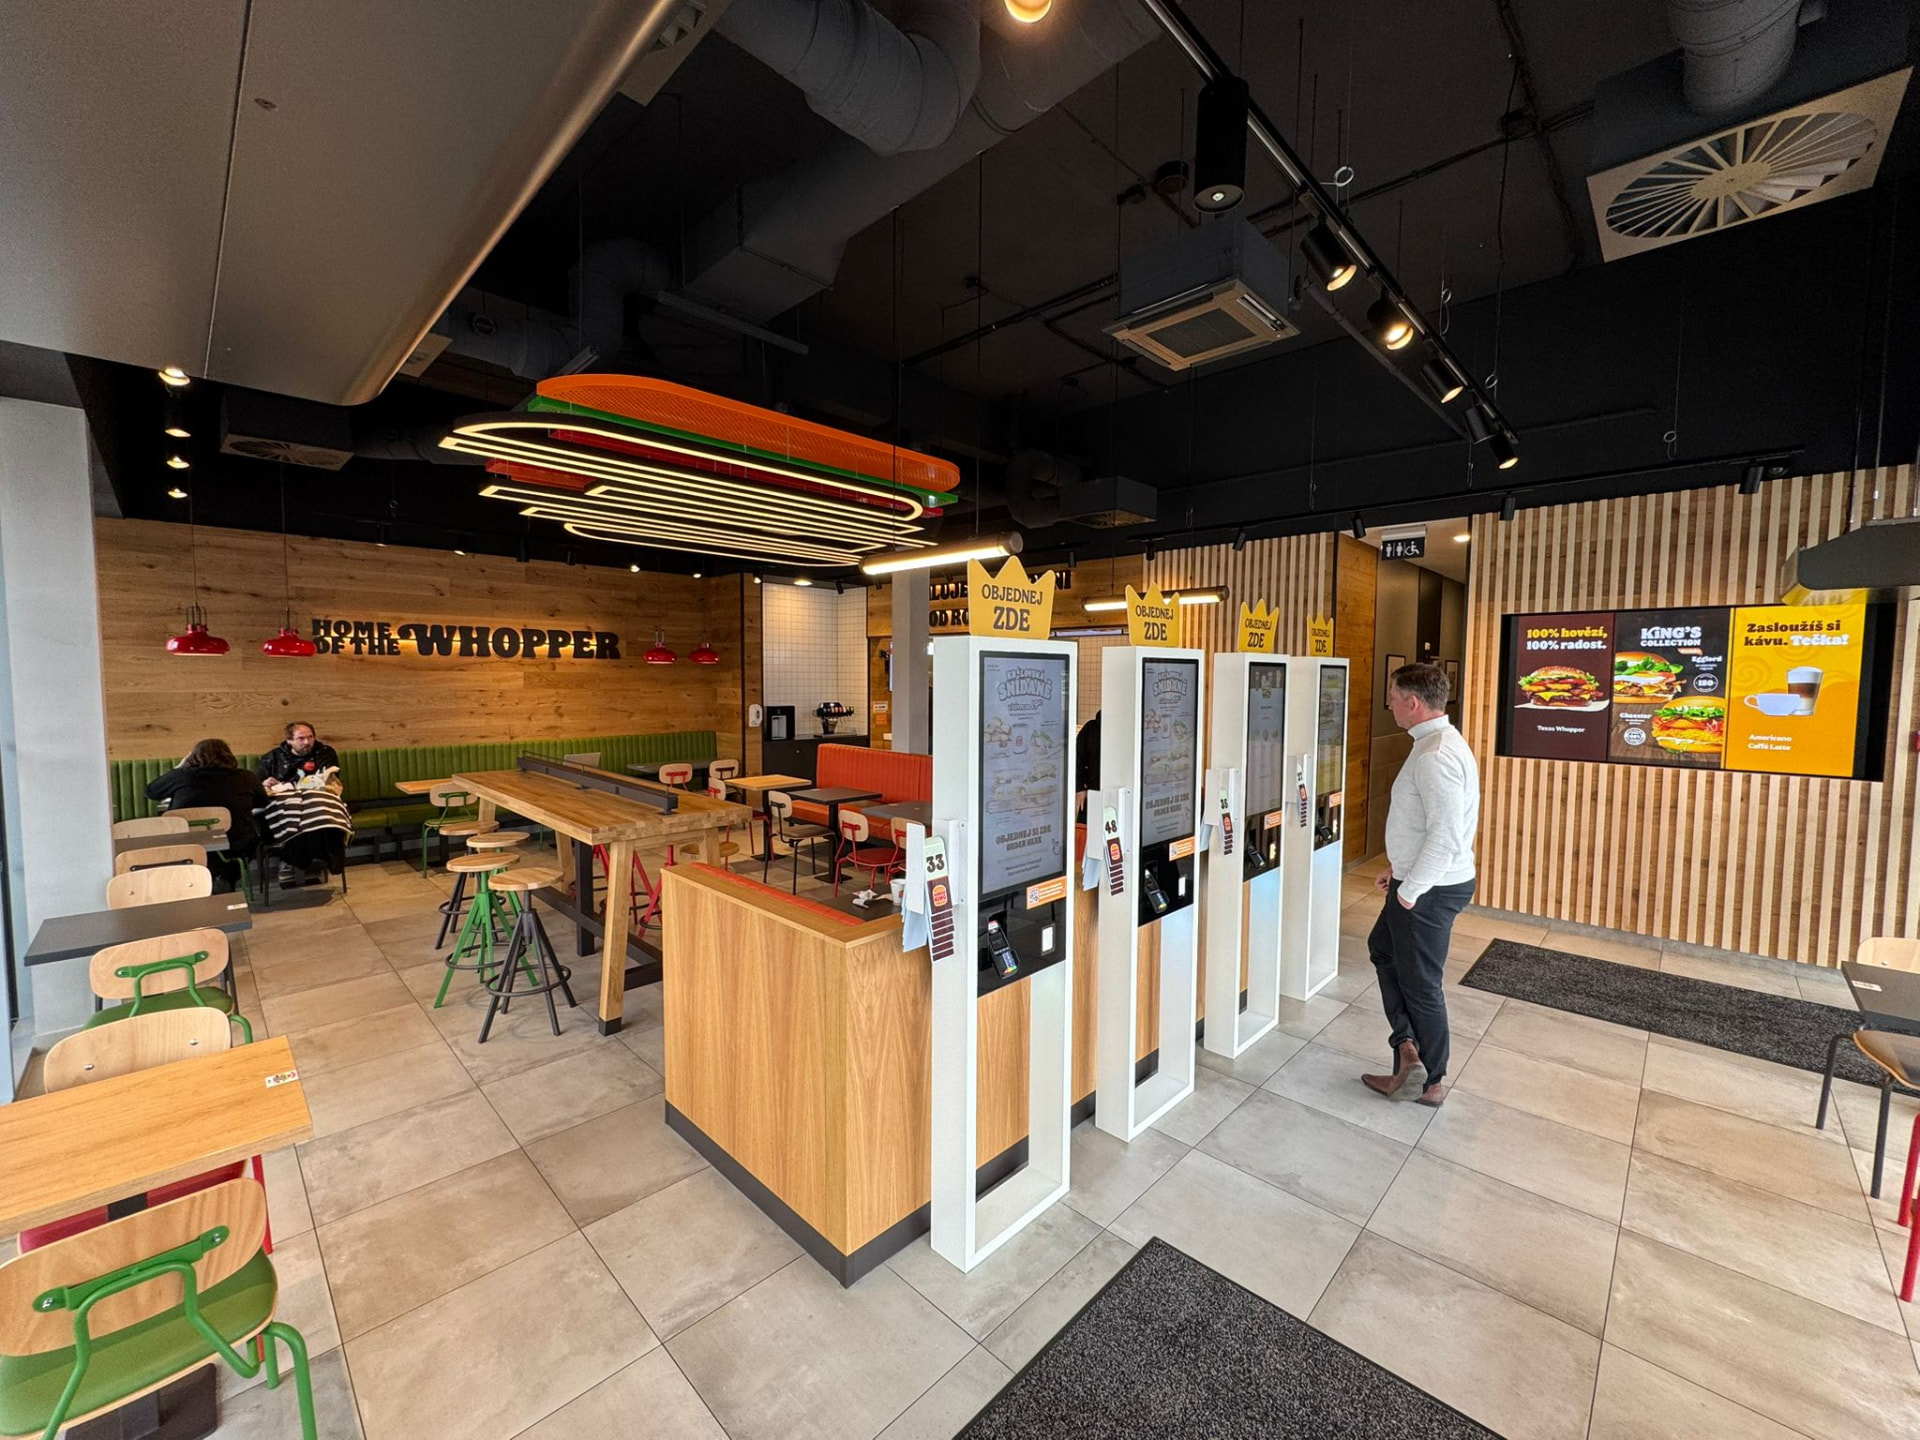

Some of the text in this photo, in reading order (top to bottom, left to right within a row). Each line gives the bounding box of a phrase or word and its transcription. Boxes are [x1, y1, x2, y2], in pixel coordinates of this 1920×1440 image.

[981, 584, 1043, 605] OBJEDNEJ
[993, 605, 1030, 631] ZDE
[1135, 604, 1174, 620] OBJEDNEJ
[312, 619, 391, 638] HOME
[1144, 621, 1167, 641] ZDE
[1244, 618, 1272, 631] OBJEDNEJ
[1526, 626, 1608, 639] 100% hovězí,
[1747, 620, 1841, 633] Zasloužíš si
[313, 636, 401, 656] OF THE
[397, 623, 621, 660] WHOPPER
[1247, 632, 1265, 648] ZDE
[1315, 639, 1327, 653] ZDE
[1526, 639, 1607, 650] 100% radost.
[1640, 639, 1701, 647] COLLECTION
[1744, 634, 1849, 646] kávu. Tečka!
[1105, 819, 1118, 834] 48
[926, 853, 945, 873] 33
